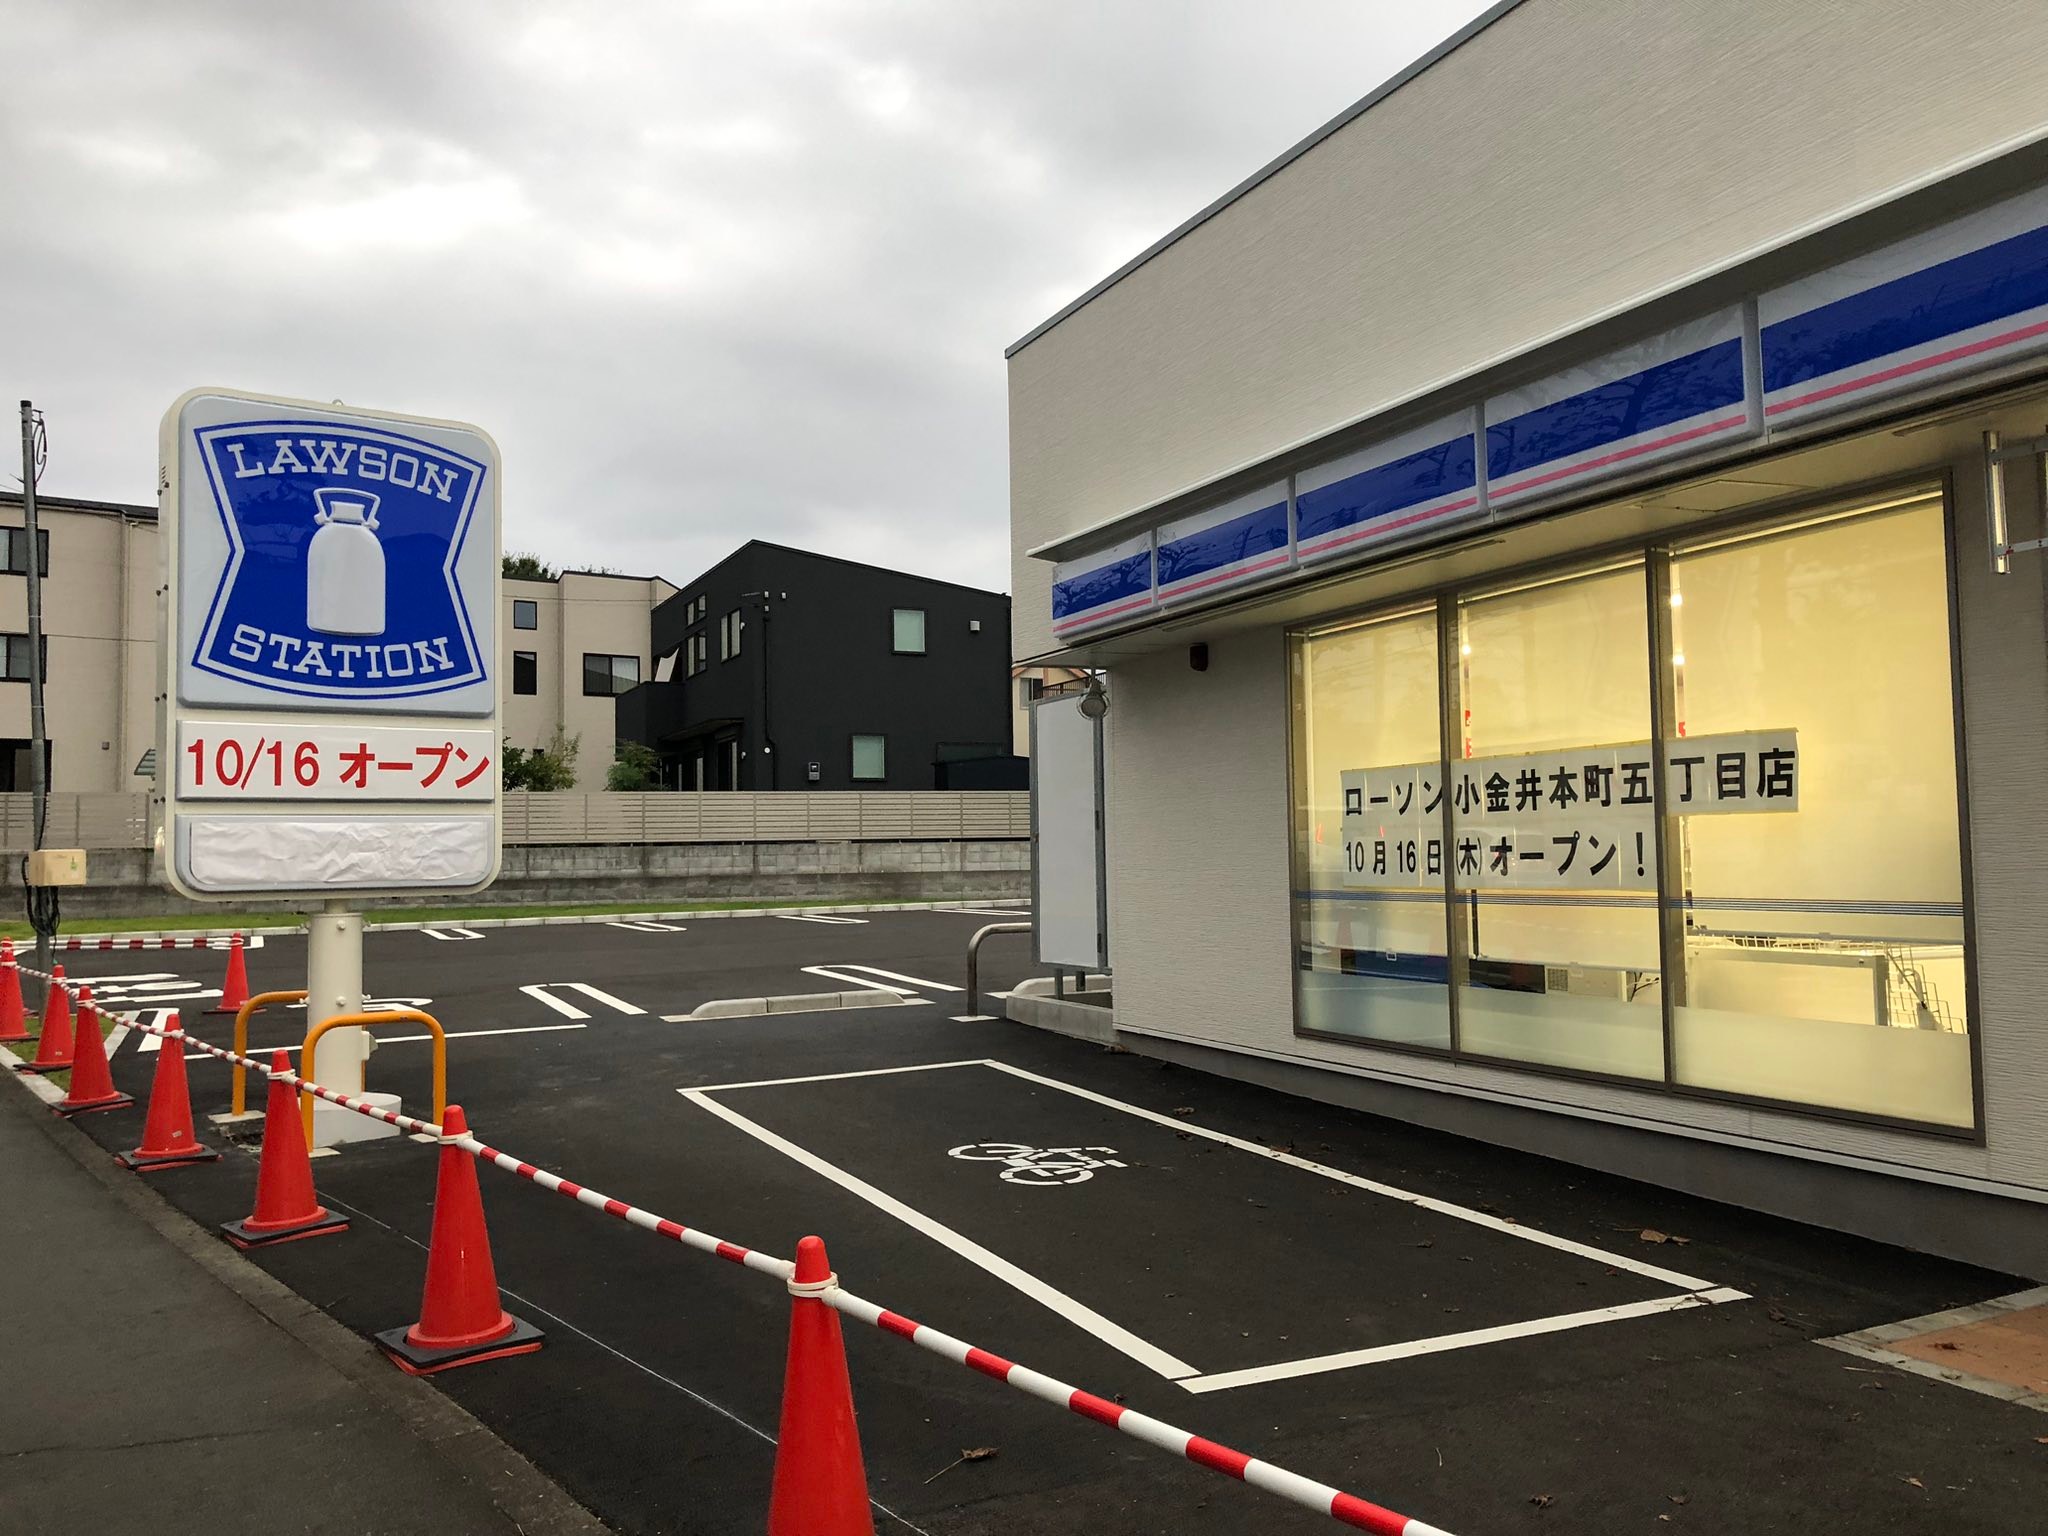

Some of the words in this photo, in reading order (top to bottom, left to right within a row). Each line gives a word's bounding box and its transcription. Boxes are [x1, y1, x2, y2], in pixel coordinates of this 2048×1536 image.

[227, 439, 458, 503] LAWSON
[229, 623, 454, 679] STATION
[187, 737, 320, 790] 10/16
[339, 741, 490, 789] オープン
[1345, 748, 1796, 816] ローソン小金井本町五丁目店
